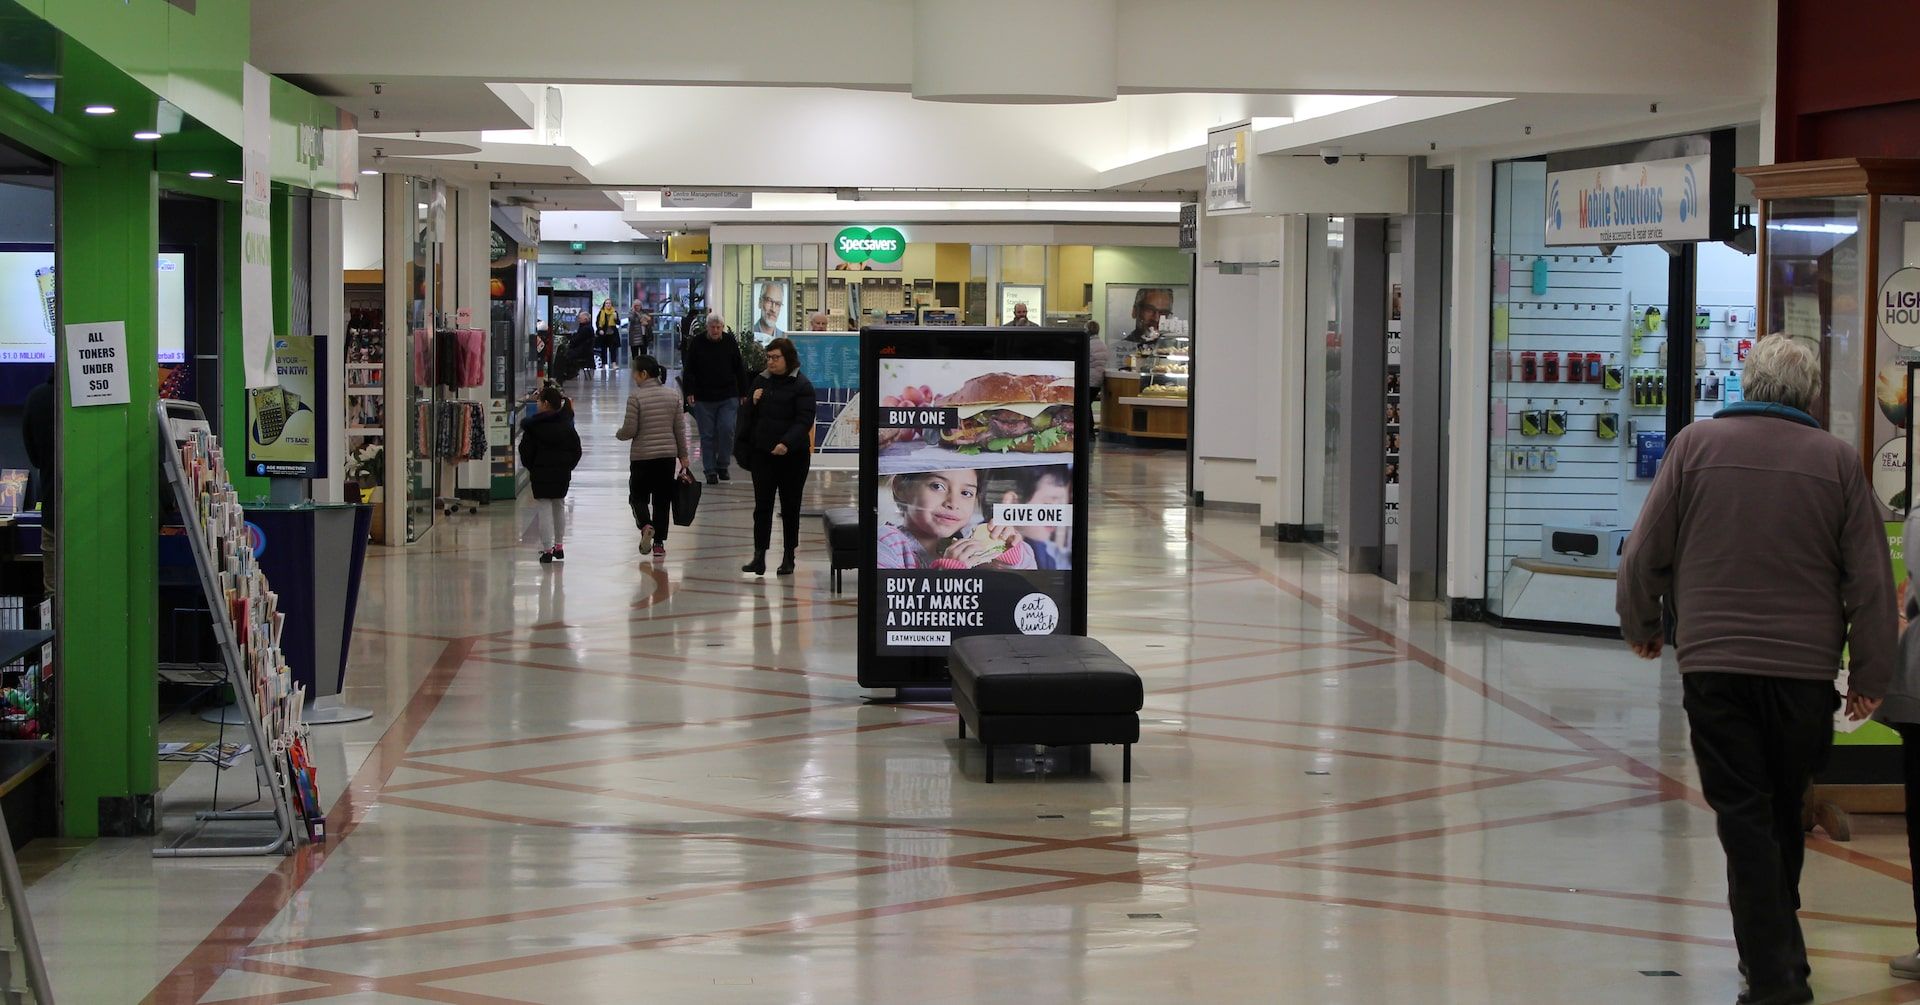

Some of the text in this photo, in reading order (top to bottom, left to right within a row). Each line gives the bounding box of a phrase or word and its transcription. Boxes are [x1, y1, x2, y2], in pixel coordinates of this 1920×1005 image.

[1579, 184, 1663, 229] Mobile Solutions
[1647, 229, 1663, 240] services
[839, 236, 897, 253] Specsavers
[553, 306, 581, 316] Every
[88, 332, 104, 343] ALL
[20, 351, 46, 359] MILLION
[79, 348, 116, 359] TONERS
[82, 363, 114, 375] UNDER
[289, 367, 308, 375] KIWI
[89, 379, 109, 391] $50
[889, 410, 946, 425] BUY ONE
[1003, 508, 1062, 522] GIVE ONE
[886, 578, 983, 593] BUY A LUNCH
[886, 594, 979, 610] THAT MAKES
[1022, 597, 1046, 612] eat
[886, 611, 984, 627] A DIFFERENCE
[1021, 614, 1055, 631] lunch
[1026, 611, 1048, 623] my
[891, 634, 945, 642] EATMYLUNCH.NZ
